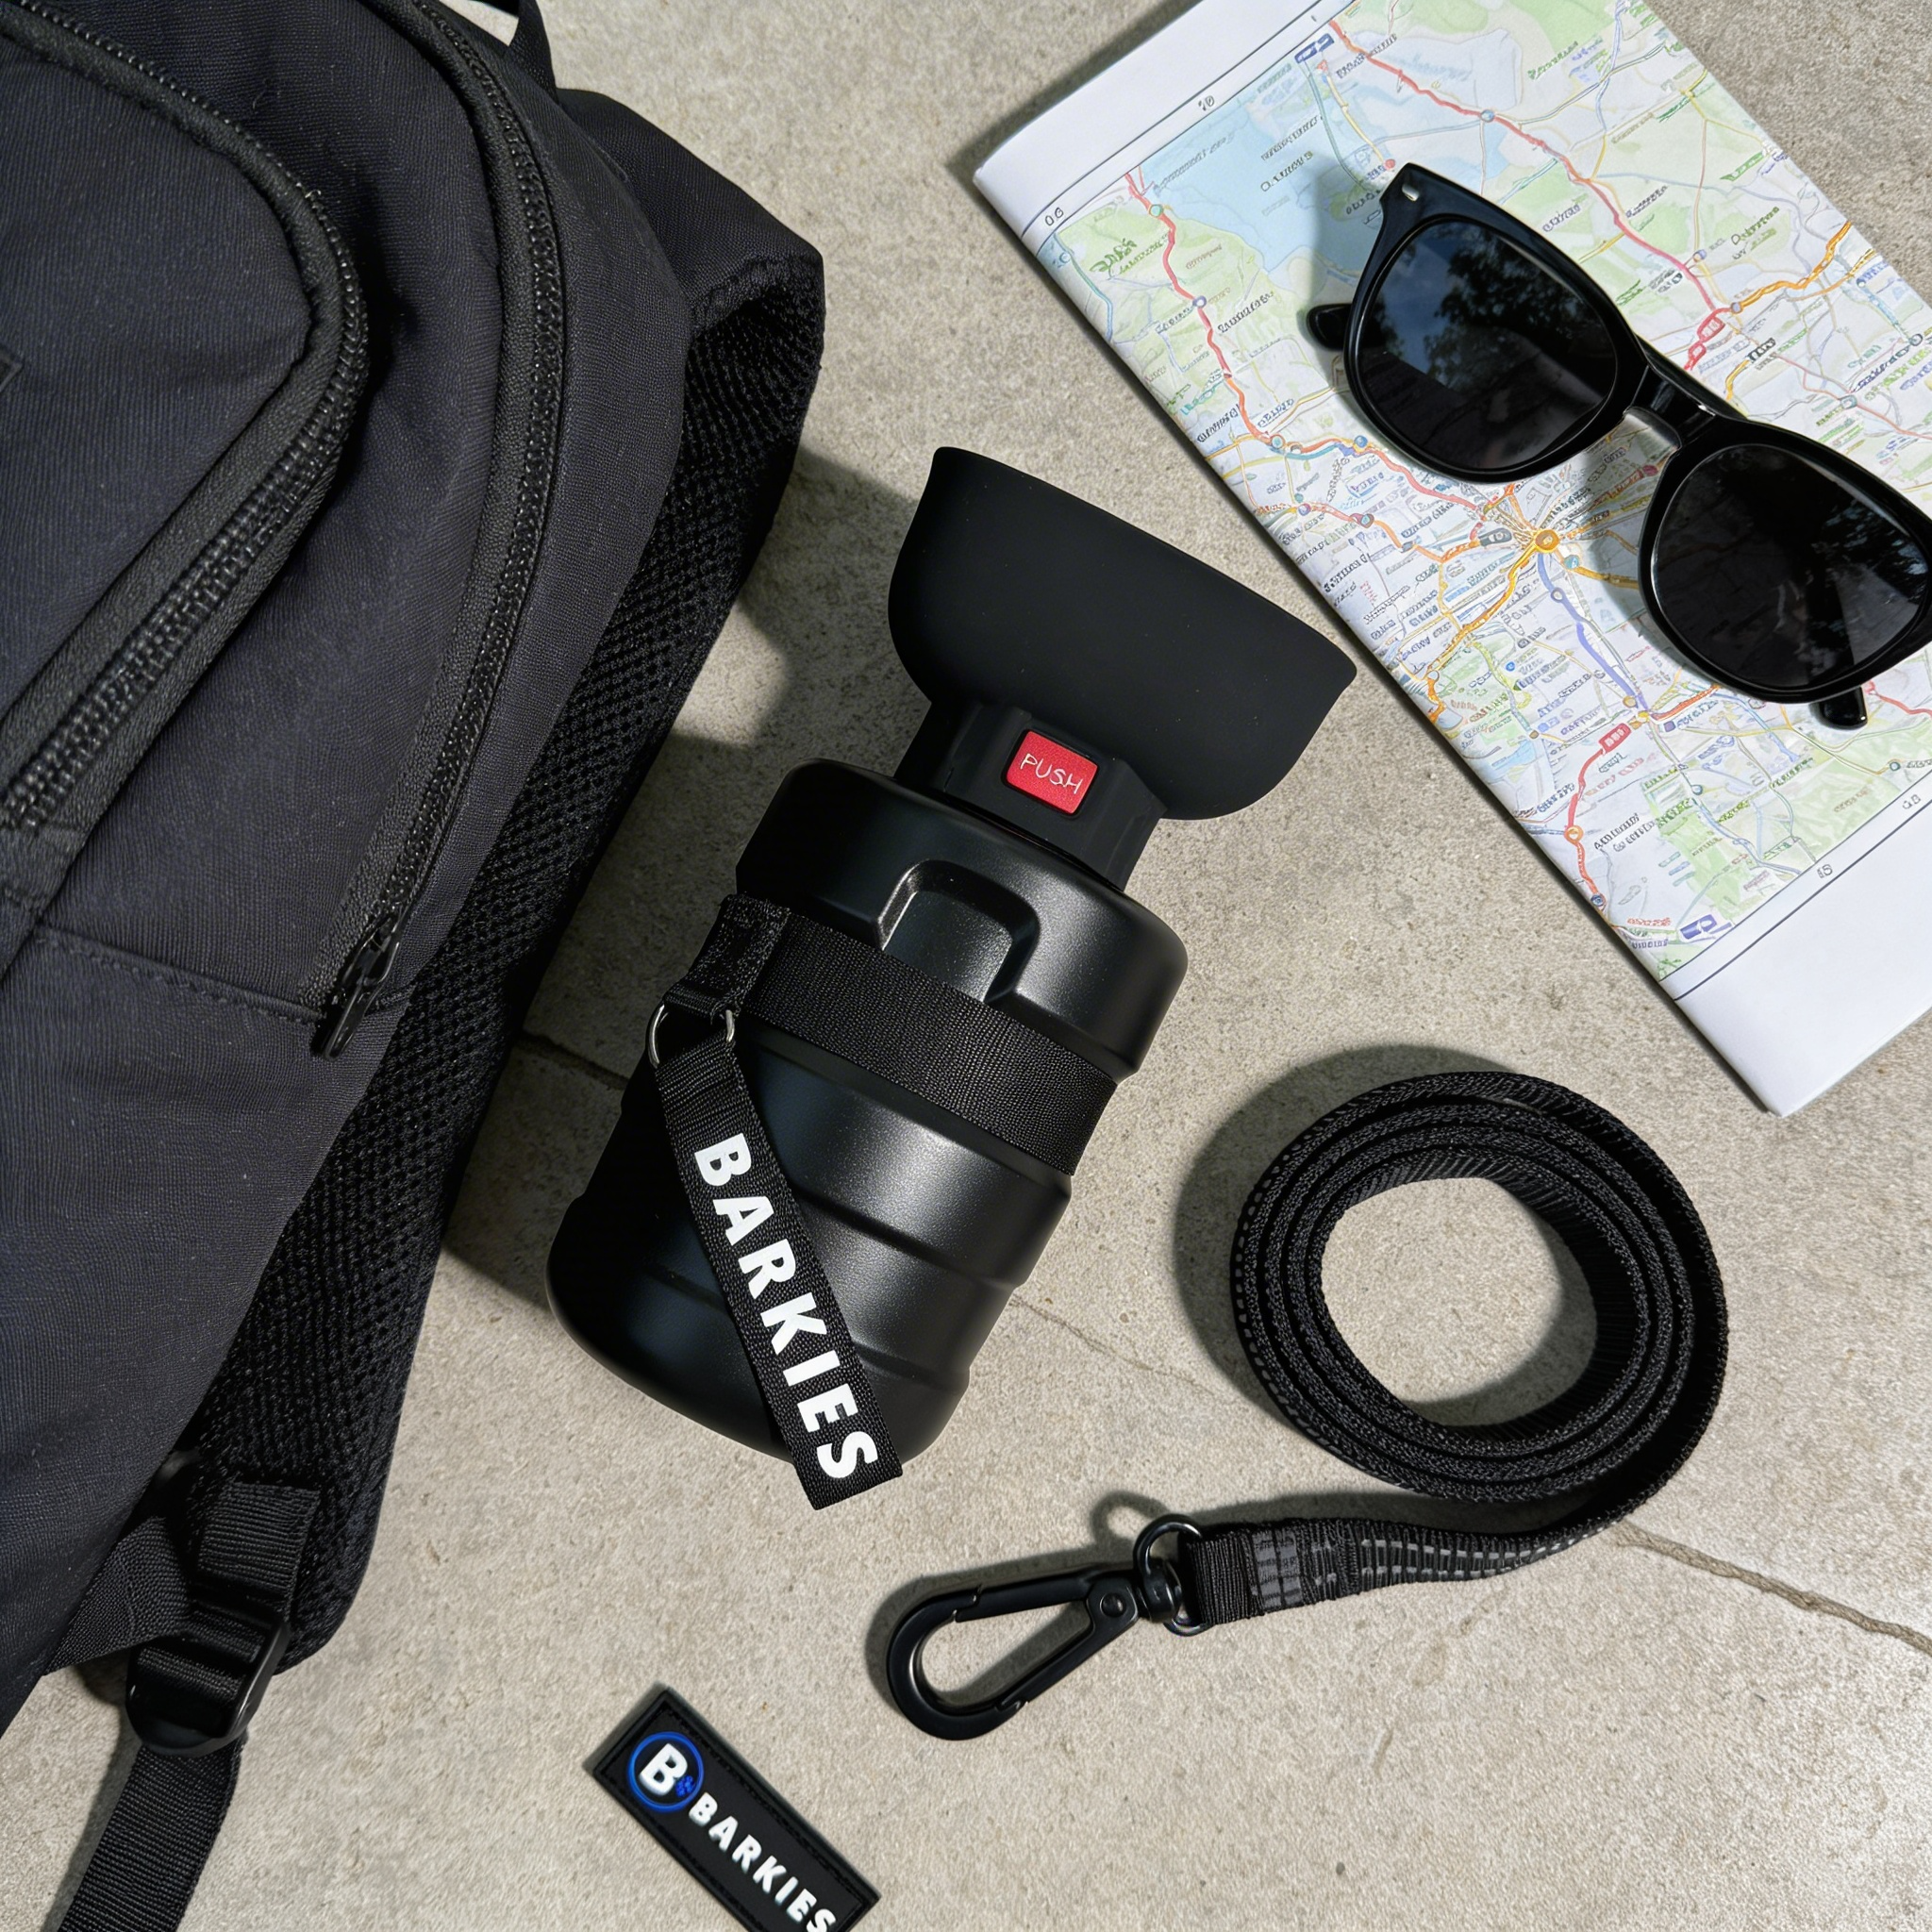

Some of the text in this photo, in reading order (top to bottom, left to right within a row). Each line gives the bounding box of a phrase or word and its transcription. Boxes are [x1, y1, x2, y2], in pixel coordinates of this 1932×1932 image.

[1020, 753, 1084, 794] PUSH
[694, 1133, 878, 1479] BARKIES
[639, 1743, 689, 1796] B
[688, 1791, 837, 1932] BARKIES
